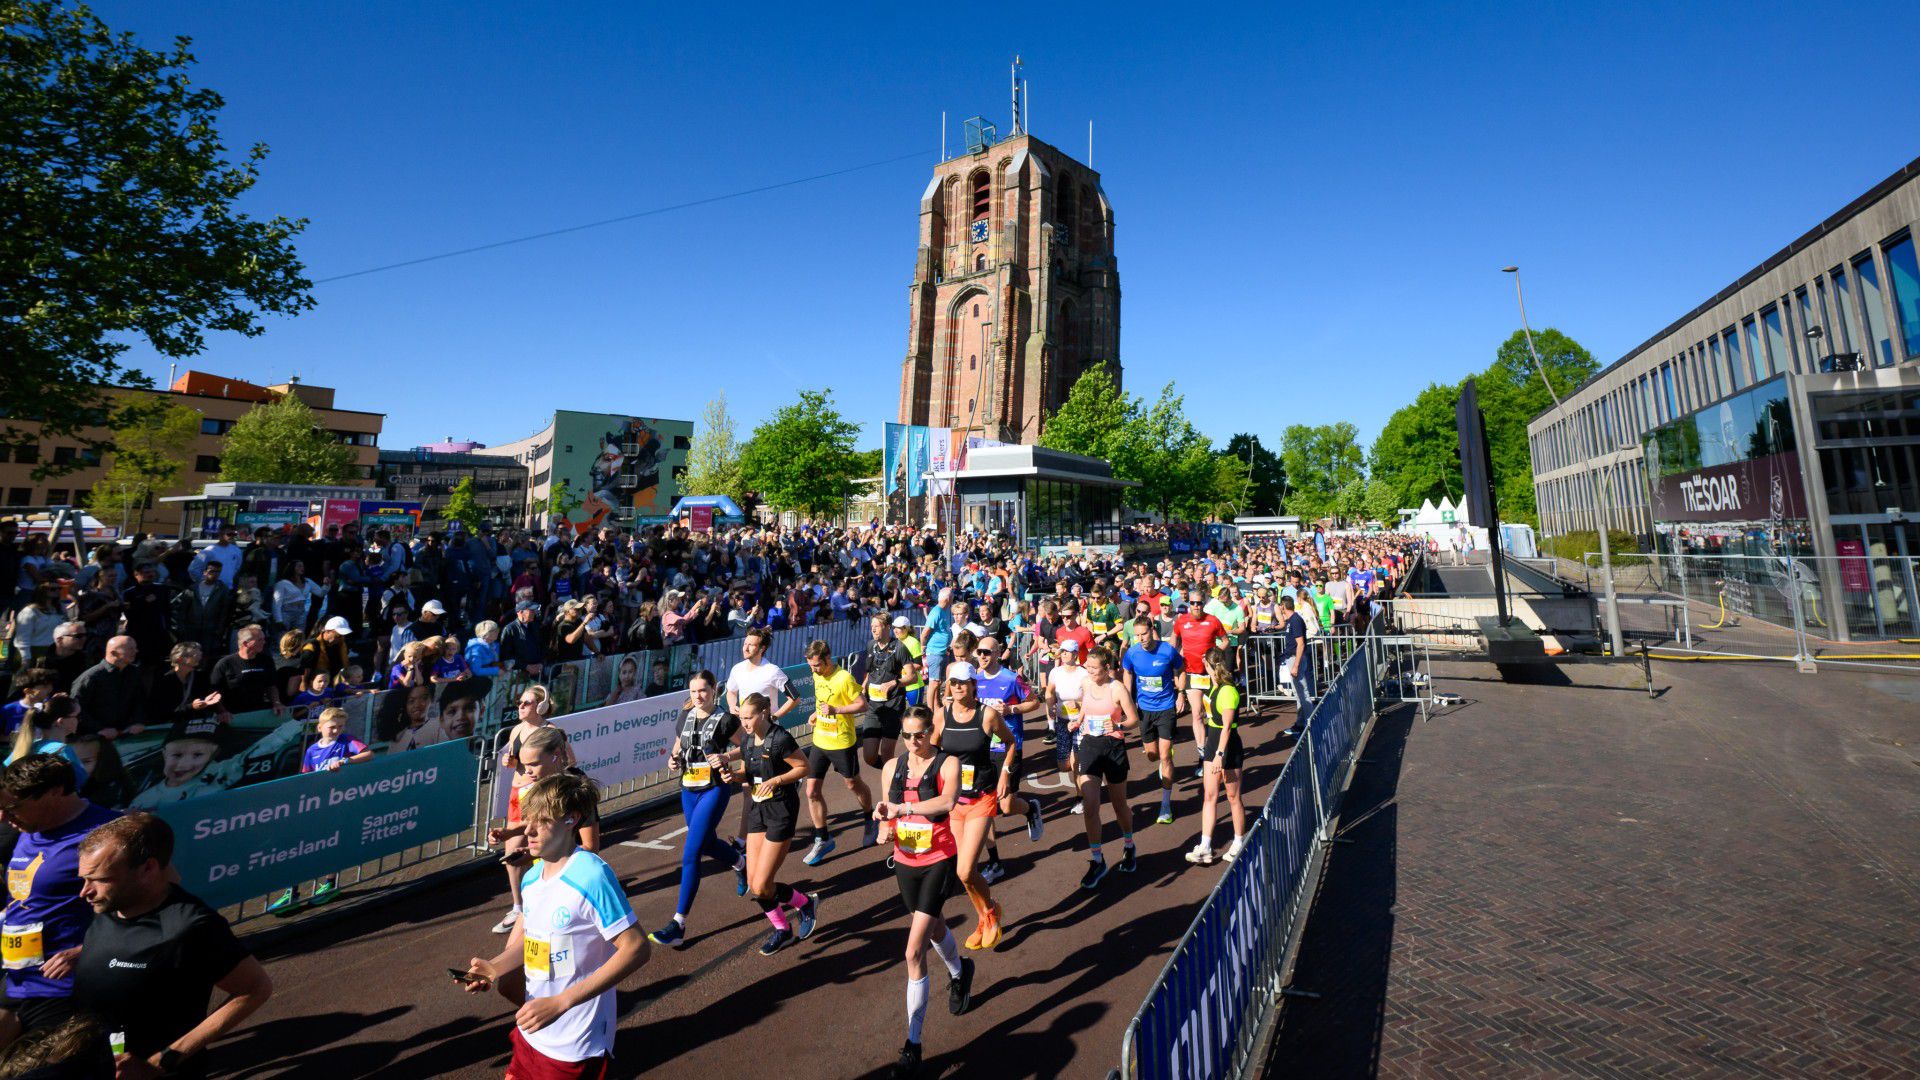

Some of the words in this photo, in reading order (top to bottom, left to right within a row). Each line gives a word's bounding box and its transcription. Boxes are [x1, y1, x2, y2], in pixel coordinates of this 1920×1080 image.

[260, 514, 294, 522] Friesland
[503, 710, 519, 722] Z8
[596, 723, 609, 738] in
[614, 709, 679, 734] beweging
[634, 737, 668, 753] Samen
[633, 749, 659, 764] Fitter
[246, 759, 272, 776] Z8
[193, 803, 290, 840] Samen
[298, 794, 321, 813] in
[329, 766, 438, 806] beweging
[362, 805, 419, 830] Samen
[361, 821, 406, 845] Fitter
[208, 862, 240, 882] De
[248, 831, 340, 871] Friesland
[117, 961, 148, 970] MEDIAHUIS
